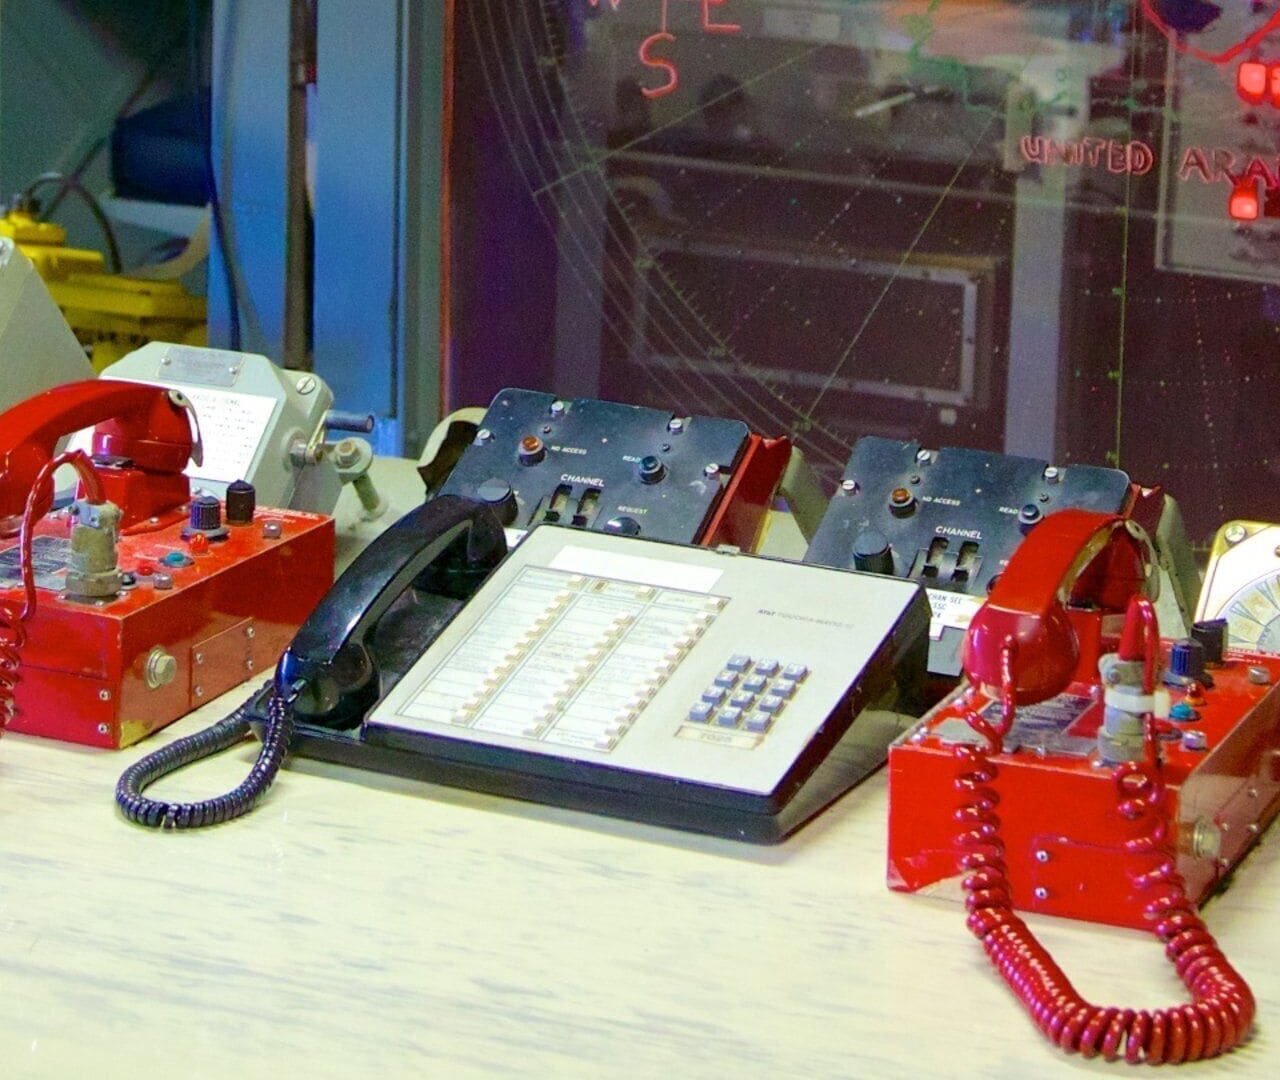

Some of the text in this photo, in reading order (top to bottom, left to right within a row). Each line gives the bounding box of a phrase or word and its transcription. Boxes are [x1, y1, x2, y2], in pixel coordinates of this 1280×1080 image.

[638, 32, 678, 99] S
[1020, 135, 1154, 176] UNITED
[551, 444, 587, 456] NO ACCESS
[560, 472, 606, 488] CHANNEL
[922, 495, 961, 508] NO ACCESS
[617, 504, 649, 515] REQUEST
[935, 525, 983, 540] CHANNEL
